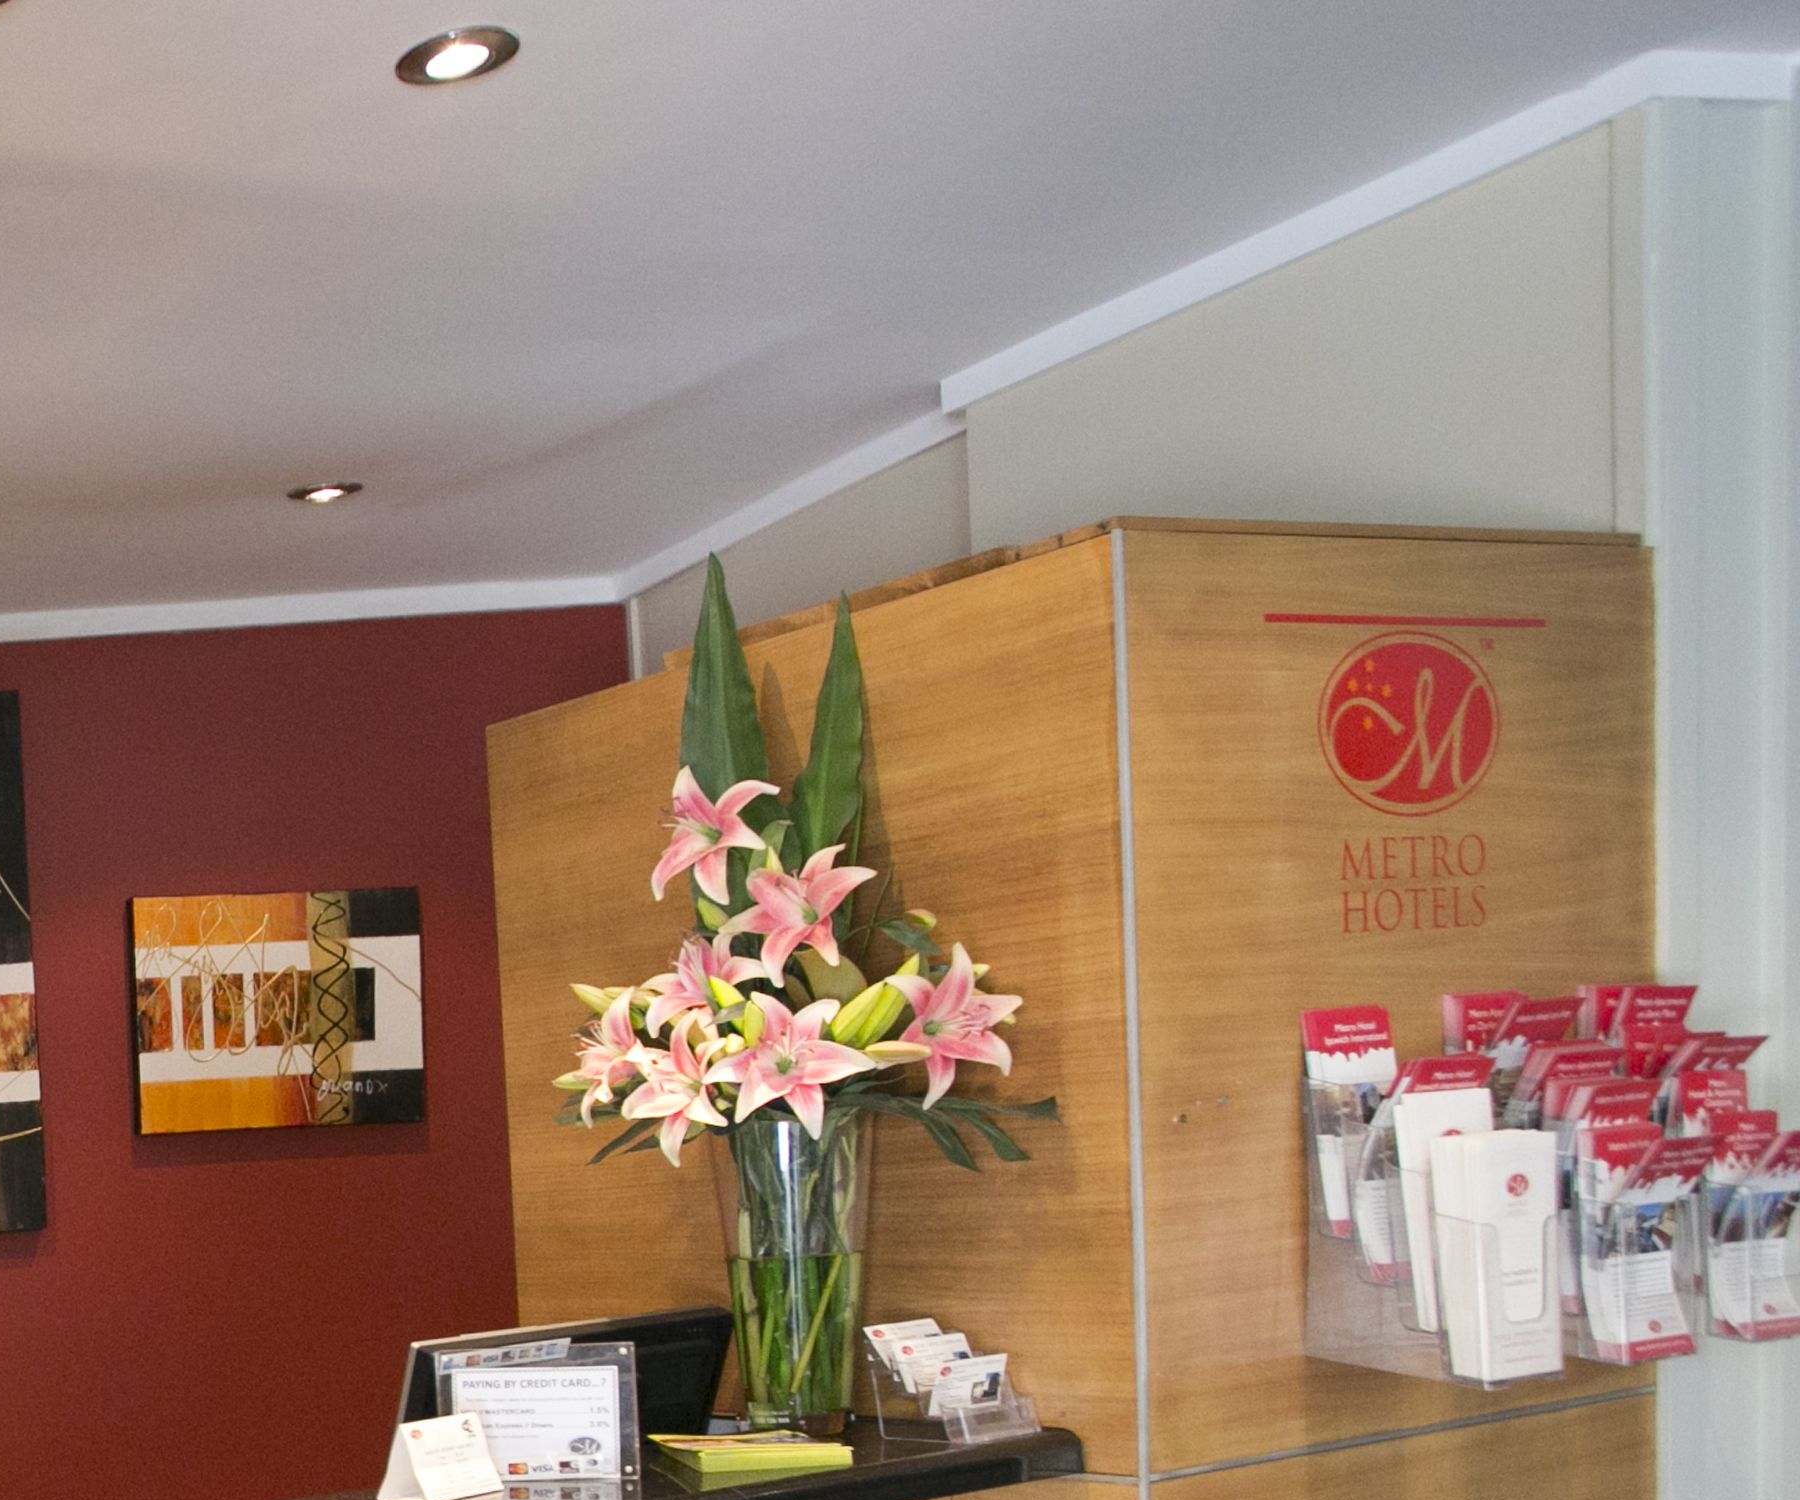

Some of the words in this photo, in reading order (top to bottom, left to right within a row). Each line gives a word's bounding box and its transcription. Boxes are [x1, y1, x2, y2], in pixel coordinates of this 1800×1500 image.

[1340, 833, 1487, 881] METRO
[1341, 885, 1488, 933] HOTELS
[462, 1379, 501, 1390] PAYING
[504, 1380, 517, 1389] BY
[520, 1379, 558, 1389] CREDIT
[531, 1465, 555, 1474] VISA
